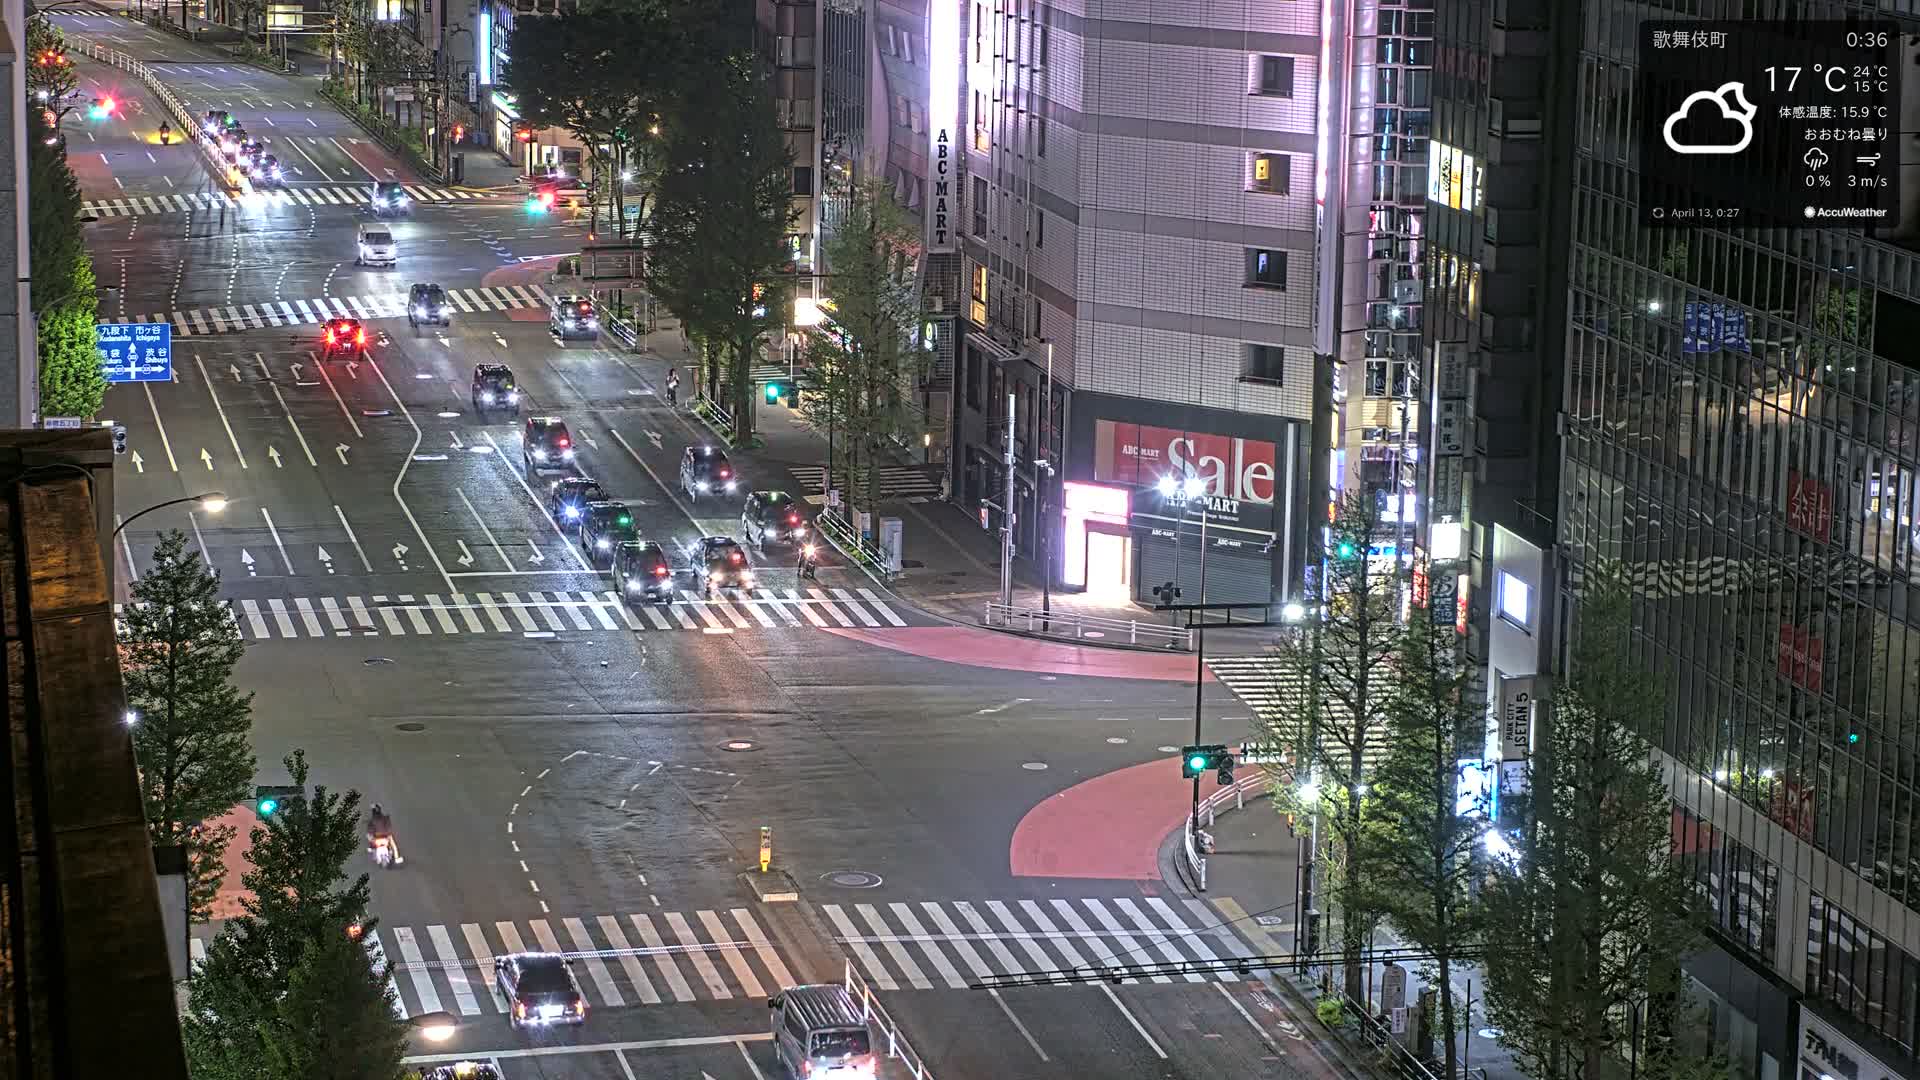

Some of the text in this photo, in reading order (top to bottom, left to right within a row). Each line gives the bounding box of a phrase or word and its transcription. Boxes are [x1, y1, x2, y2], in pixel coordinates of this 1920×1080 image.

[101, 326, 130, 335] 九段下
[135, 334, 161, 343] Ichigaya
[145, 347, 168, 357] 渋谷
[144, 356, 169, 365] Shibuya
[1167, 437, 1275, 505] Sale
[1505, 703, 1515, 741] PARK CITY
[1514, 692, 1529, 747] ISETAN 5
